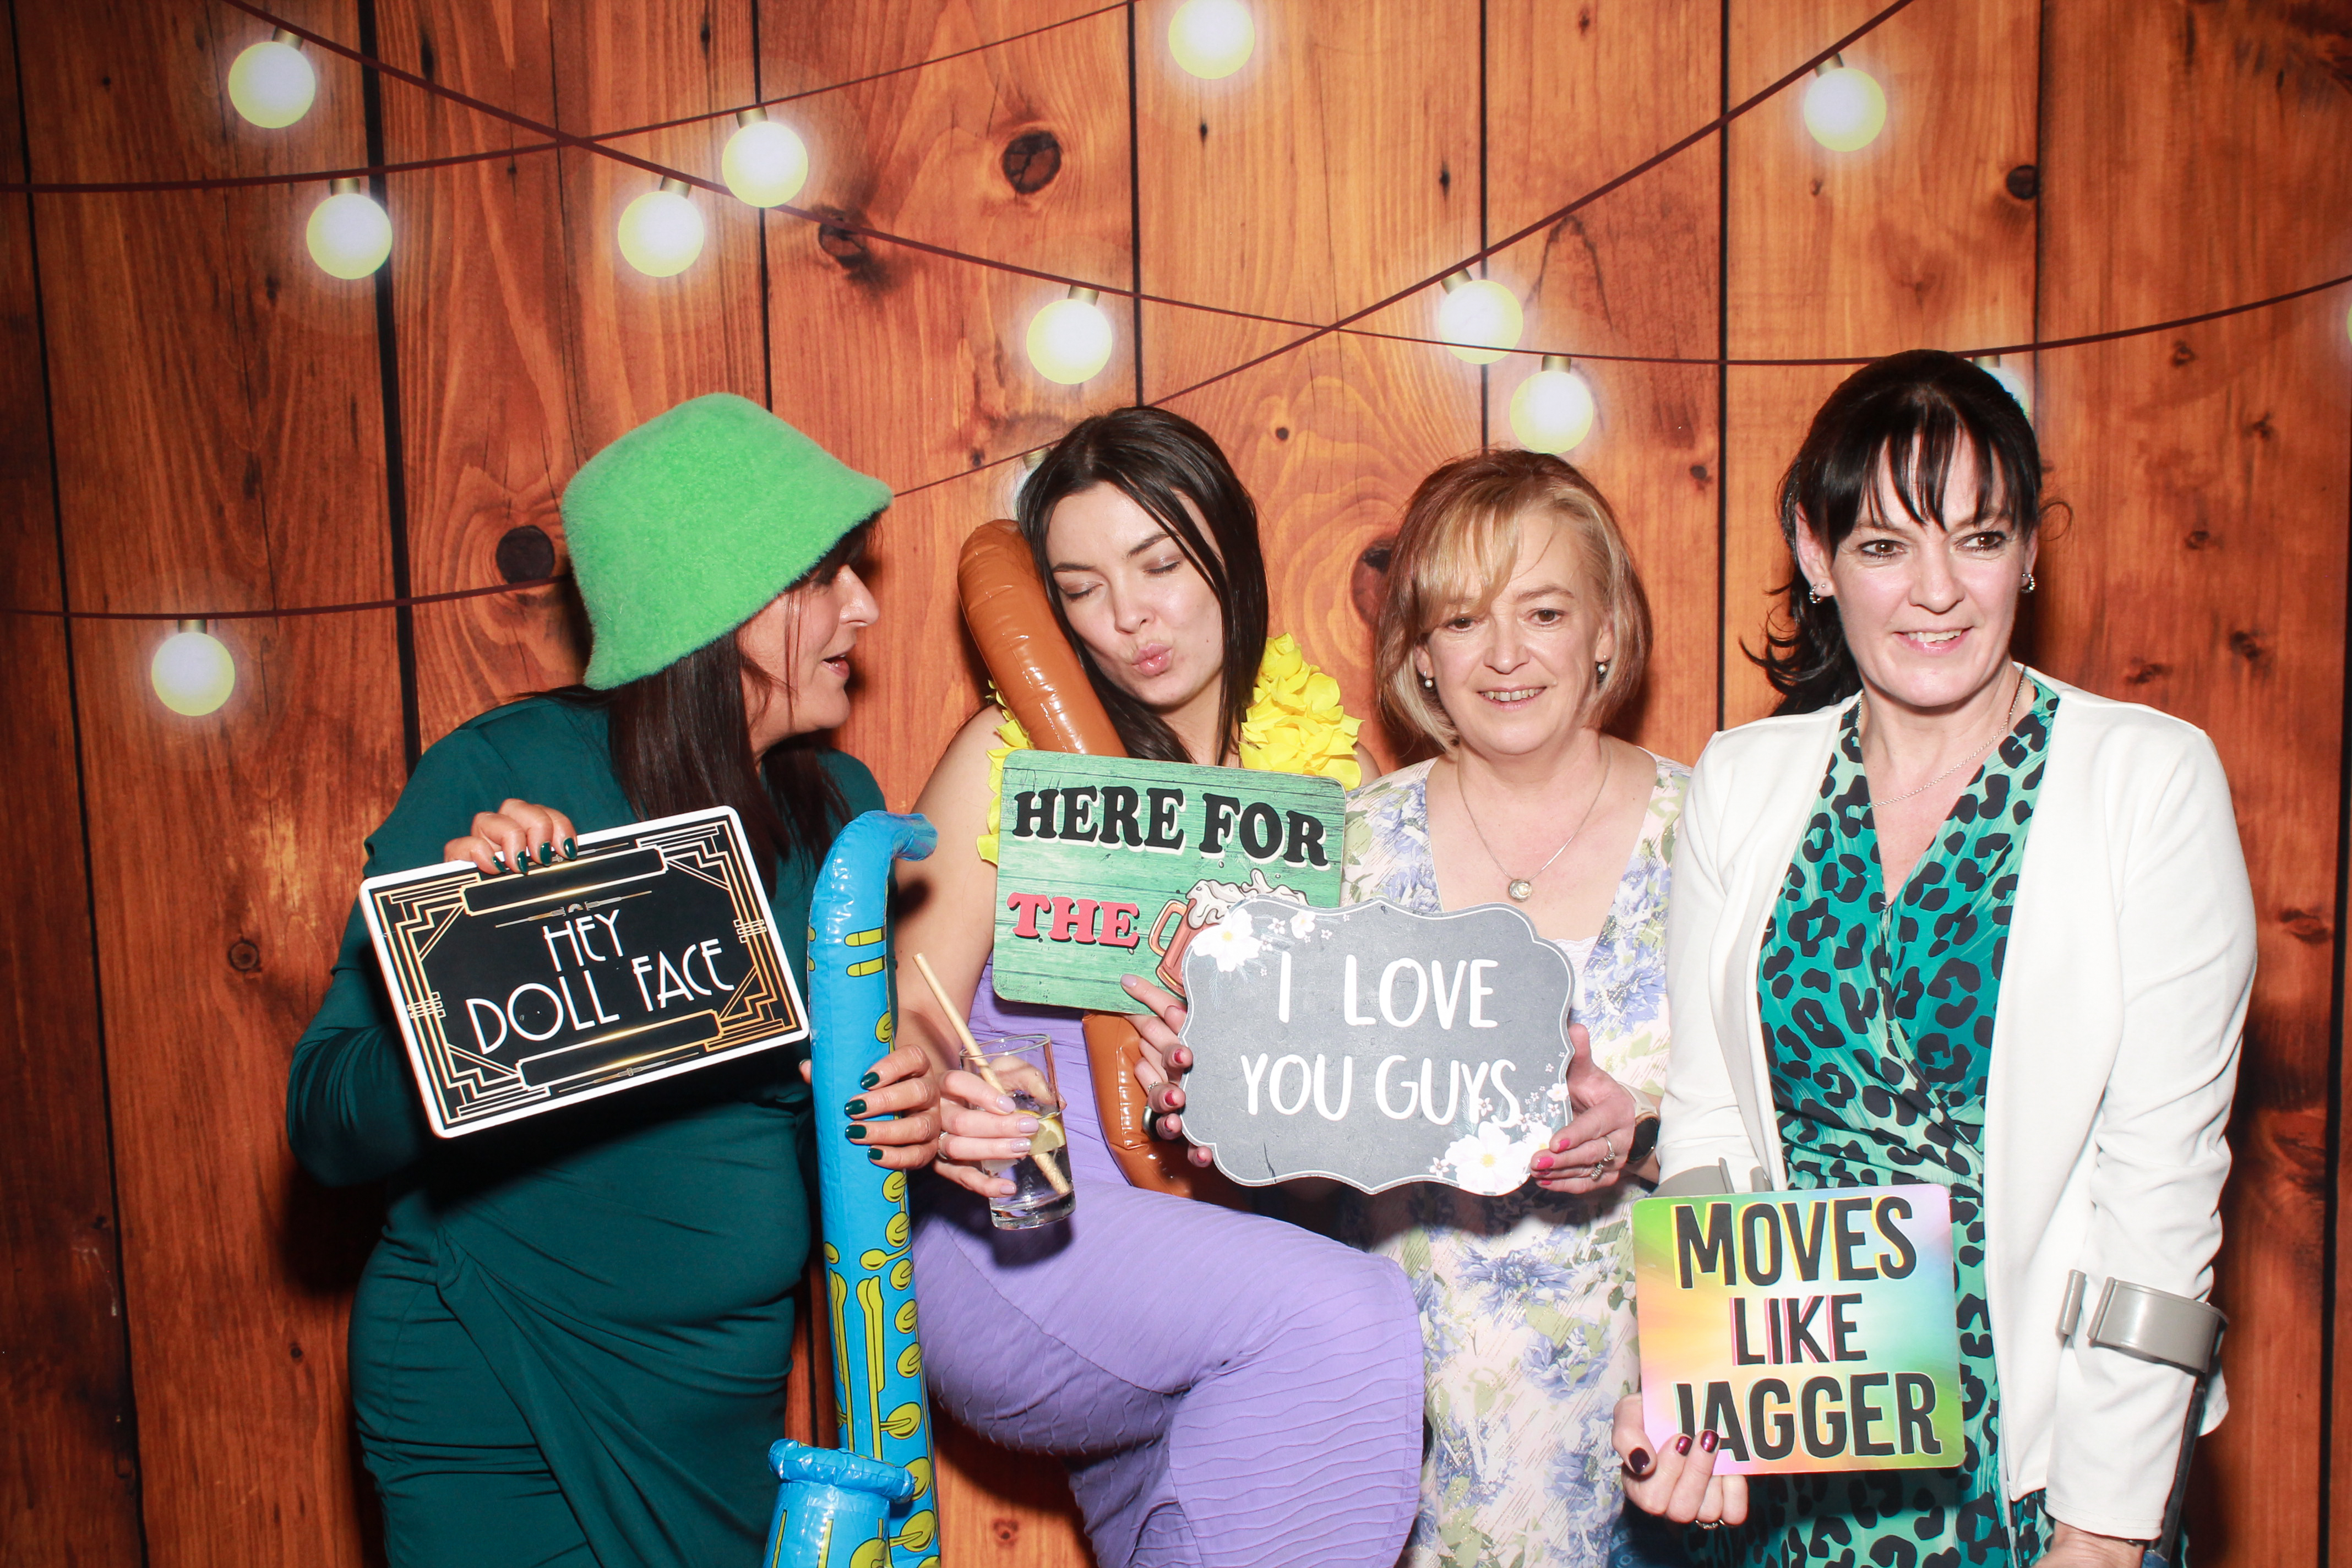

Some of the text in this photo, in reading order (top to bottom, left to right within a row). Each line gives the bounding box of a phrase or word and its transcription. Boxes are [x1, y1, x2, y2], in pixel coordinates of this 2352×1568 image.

[1012, 785, 1331, 870] HERE FOR
[542, 909, 624, 972] HEY
[1007, 892, 1140, 950] THE
[465, 938, 735, 1055] DOLL FACE
[1278, 951, 1499, 1030] I LOVE
[1240, 1053, 1521, 1128] YOU GUYS
[1672, 1195, 1918, 1289] MOVES
[1730, 1293, 1868, 1365] LIKE
